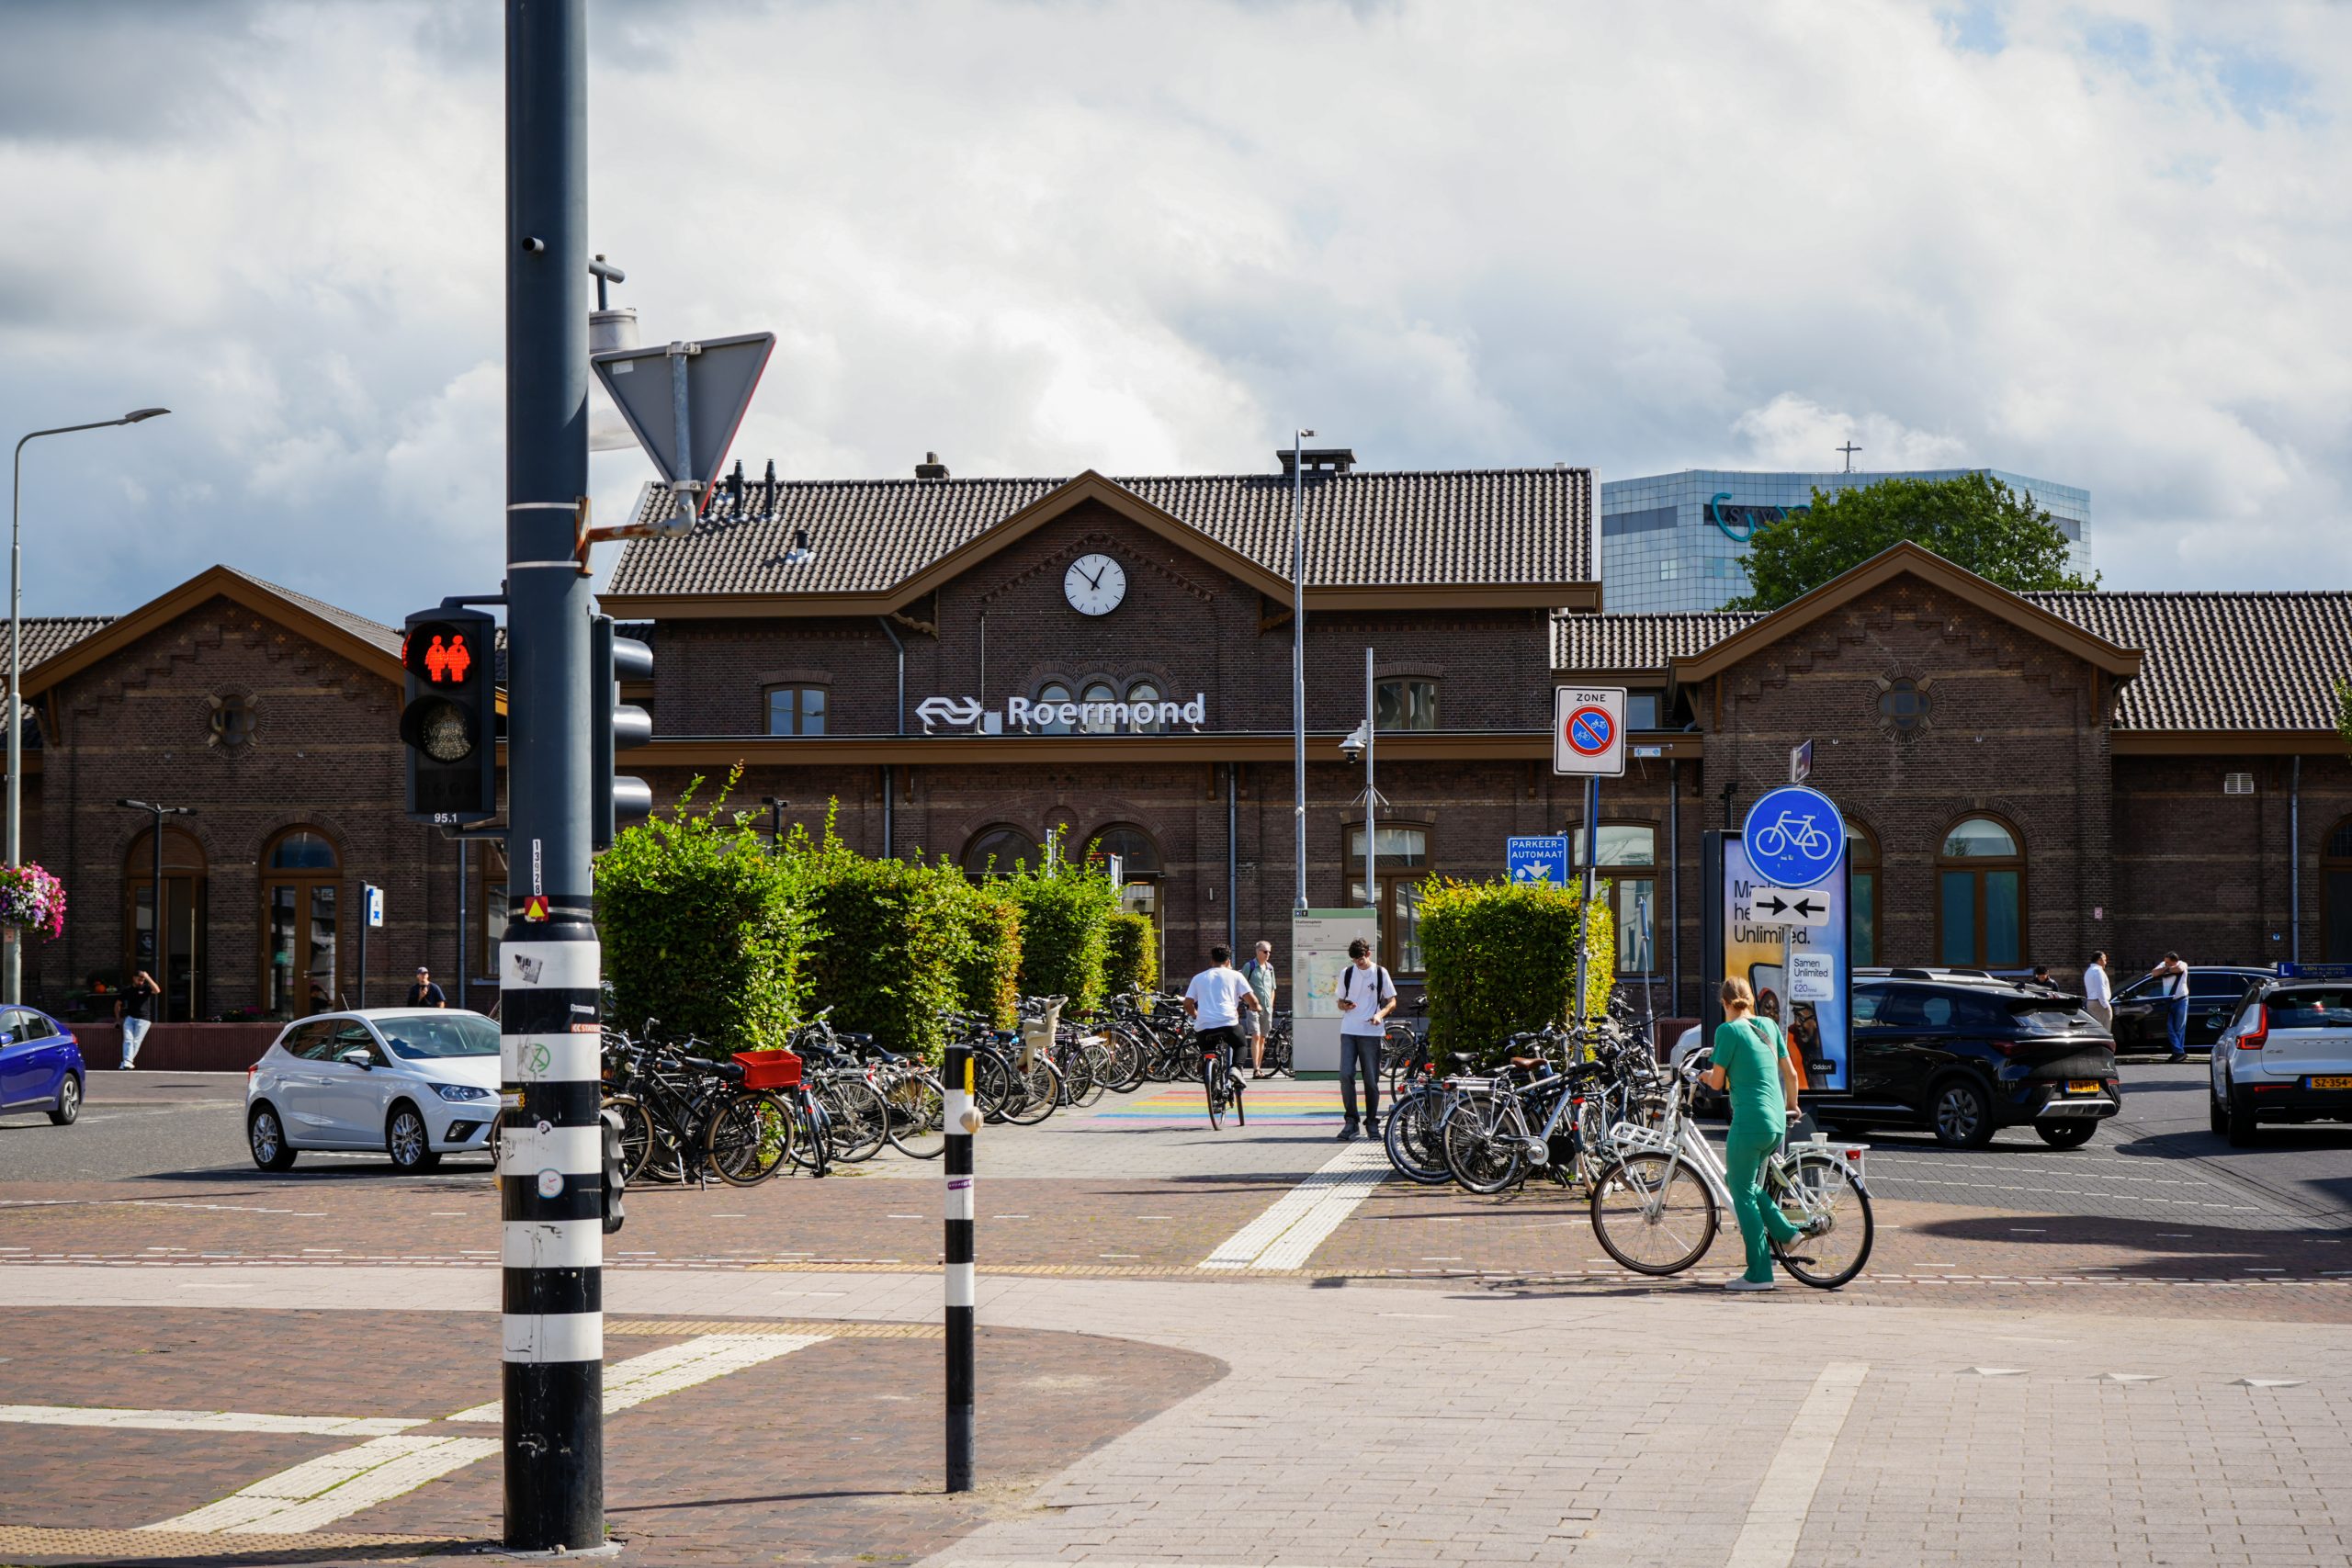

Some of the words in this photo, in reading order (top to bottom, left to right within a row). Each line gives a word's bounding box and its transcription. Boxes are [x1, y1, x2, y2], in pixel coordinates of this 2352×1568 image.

[1576, 694, 1607, 703] ZONE
[1008, 693, 1205, 726] Roermond
[434, 813, 458, 823] 95.1
[1512, 840, 1563, 849] PARKEER-
[1511, 851, 1564, 859] AUTOMAAT
[1734, 902, 1751, 921] he
[1793, 958, 1821, 968] Samen
[1793, 968, 1829, 978] Unlimited
[2280, 964, 2290, 976] L
[1793, 984, 1808, 993] €20
[2314, 1077, 2352, 1088] SZ-354-
